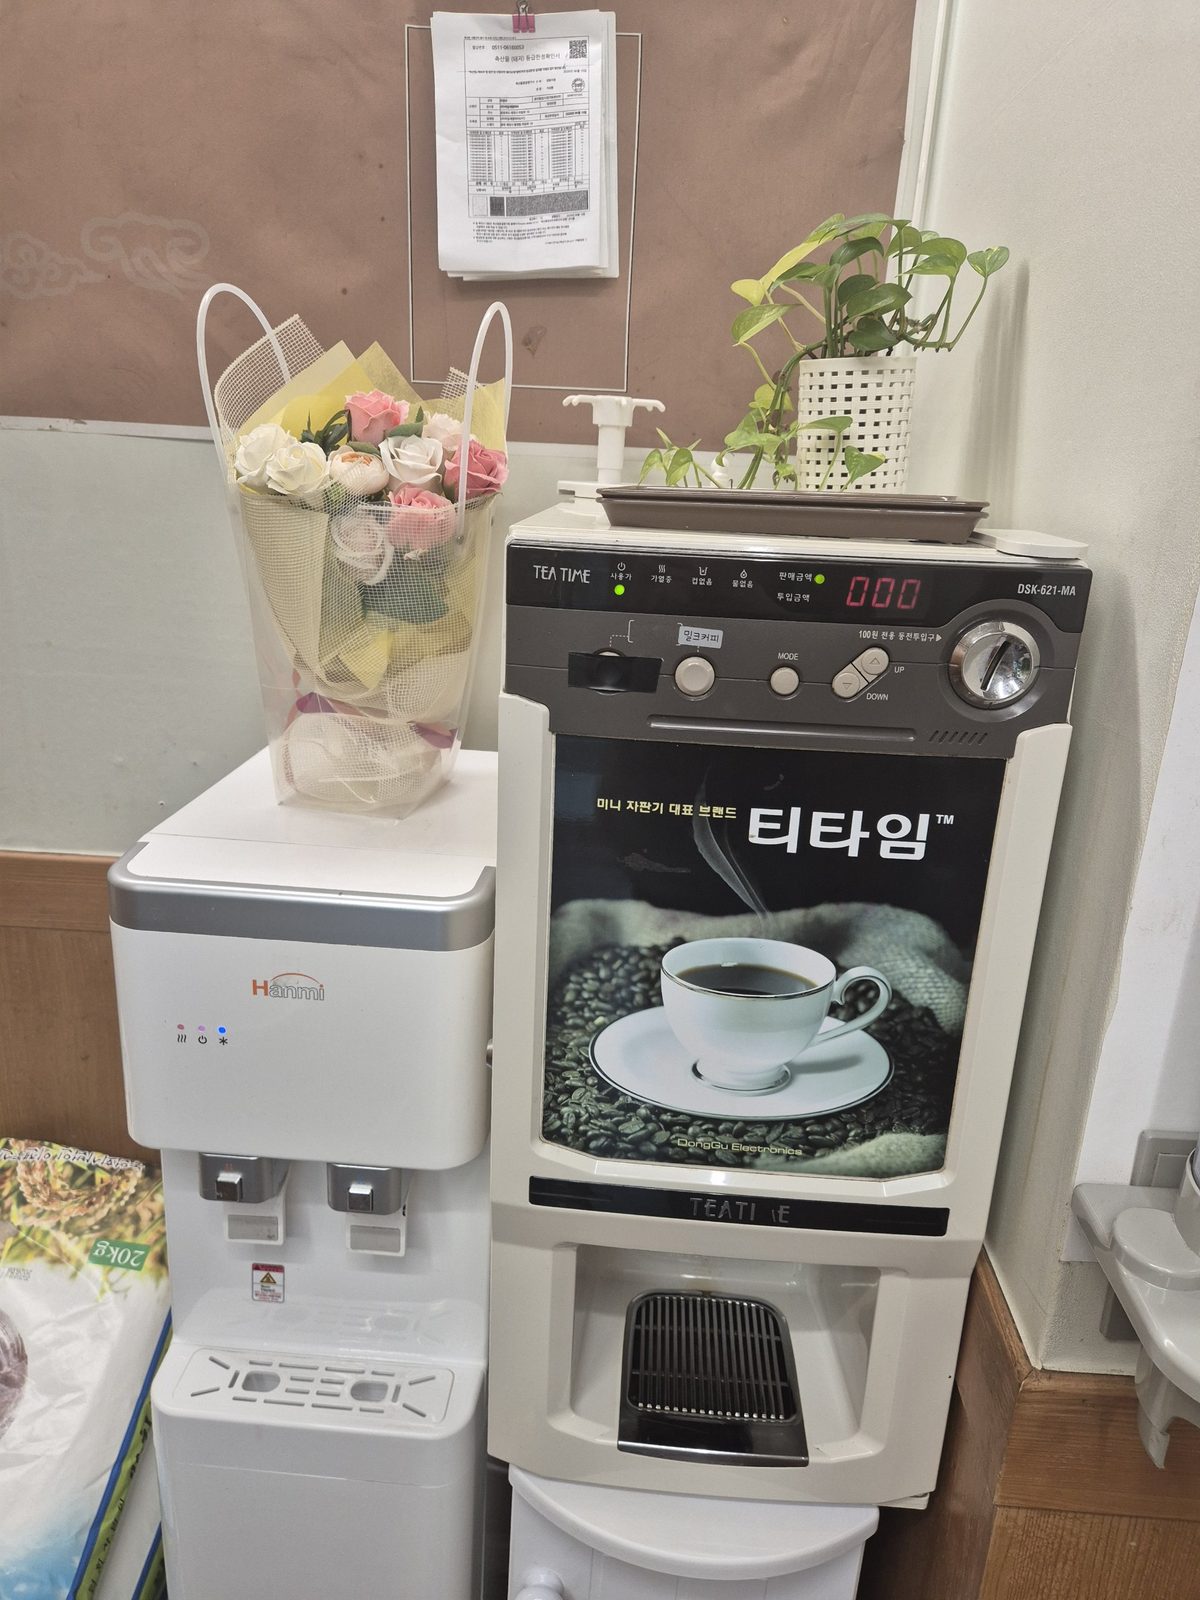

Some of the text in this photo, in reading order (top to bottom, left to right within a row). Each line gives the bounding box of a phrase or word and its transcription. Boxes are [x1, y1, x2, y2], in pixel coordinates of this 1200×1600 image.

[533, 564, 591, 584] TEA TIME
[610, 572, 632, 581] 사용가
[651, 574, 673, 584] 가열중
[779, 571, 813, 582] 판매금액
[691, 577, 713, 587] 컵없음
[846, 576, 921, 609] 000
[1017, 583, 1076, 597] DSK-621-MA
[777, 592, 811, 603] 투입금액
[859, 630, 879, 640] 100원
[898, 632, 935, 642] 동전투입구
[777, 652, 799, 661] MODE
[894, 666, 905, 674] UP
[866, 693, 889, 701] DOWN
[597, 798, 737, 819] 미니 자판기 대표 브랜드
[748, 806, 930, 861] 티타임
[252, 979, 325, 1001] Hanmi
[677, 1138, 803, 1156] DongGu Electronics
[93, 1240, 145, 1267] 20kg
